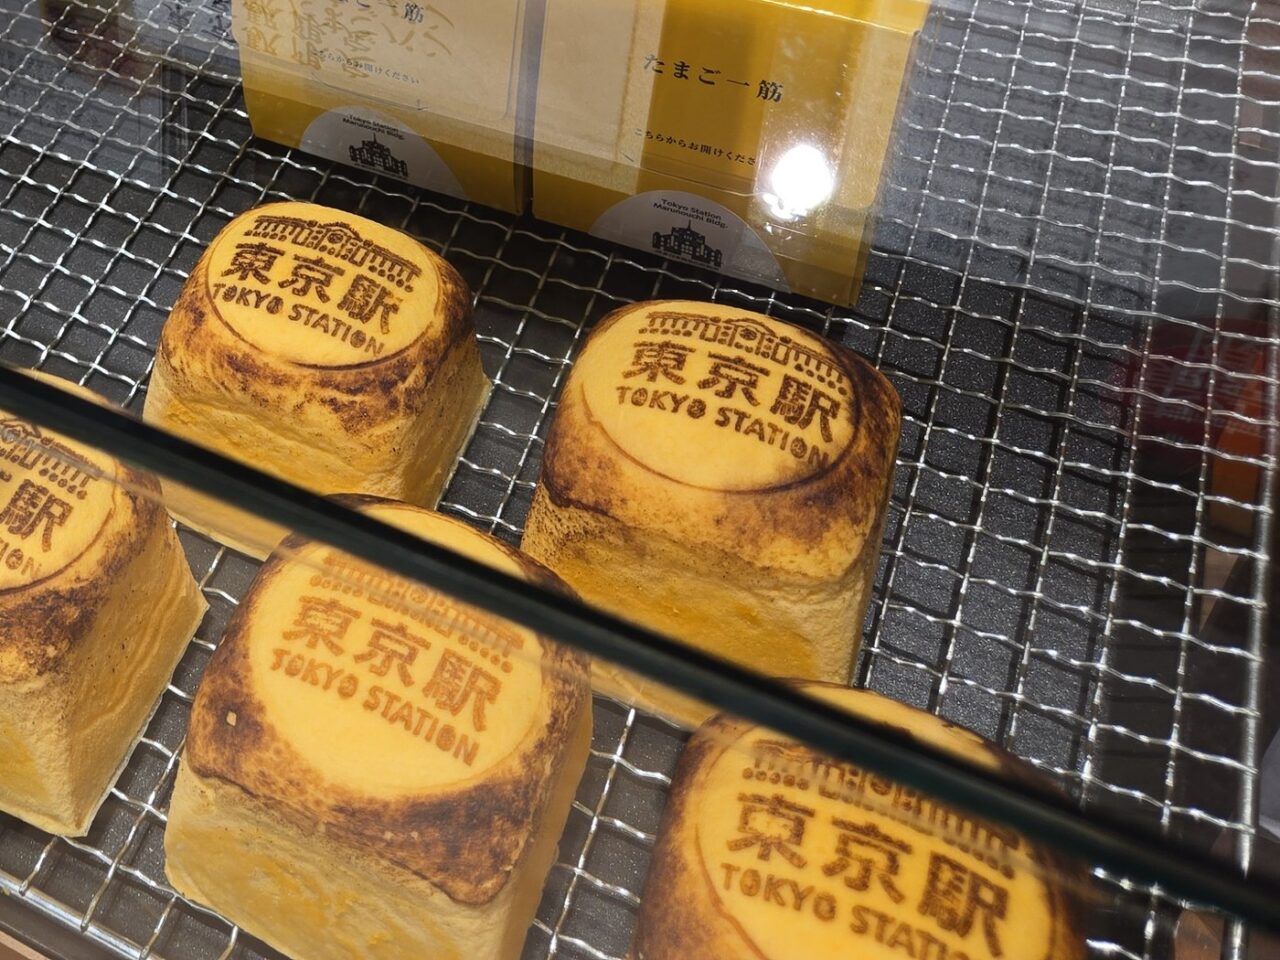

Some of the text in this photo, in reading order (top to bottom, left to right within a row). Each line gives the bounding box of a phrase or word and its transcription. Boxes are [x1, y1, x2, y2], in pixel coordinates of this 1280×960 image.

[643, 54, 785, 103] たまご一筋
[634, 128, 757, 167] こちらからお開けくださ
[653, 203, 704, 221] Marunouchi
[661, 198, 722, 220] Tokyo Station
[212, 282, 385, 357] TOKYO STATION
[220, 241, 402, 335] 東京駅
[616, 387, 828, 468] TOKYO STATION
[622, 340, 843, 446] 東京駅
[270, 647, 480, 766] TOKYO STATION
[280, 592, 504, 734] 東京駅
[720, 862, 970, 960] TOKYO STATI
[725, 791, 1011, 959] 東京駅
